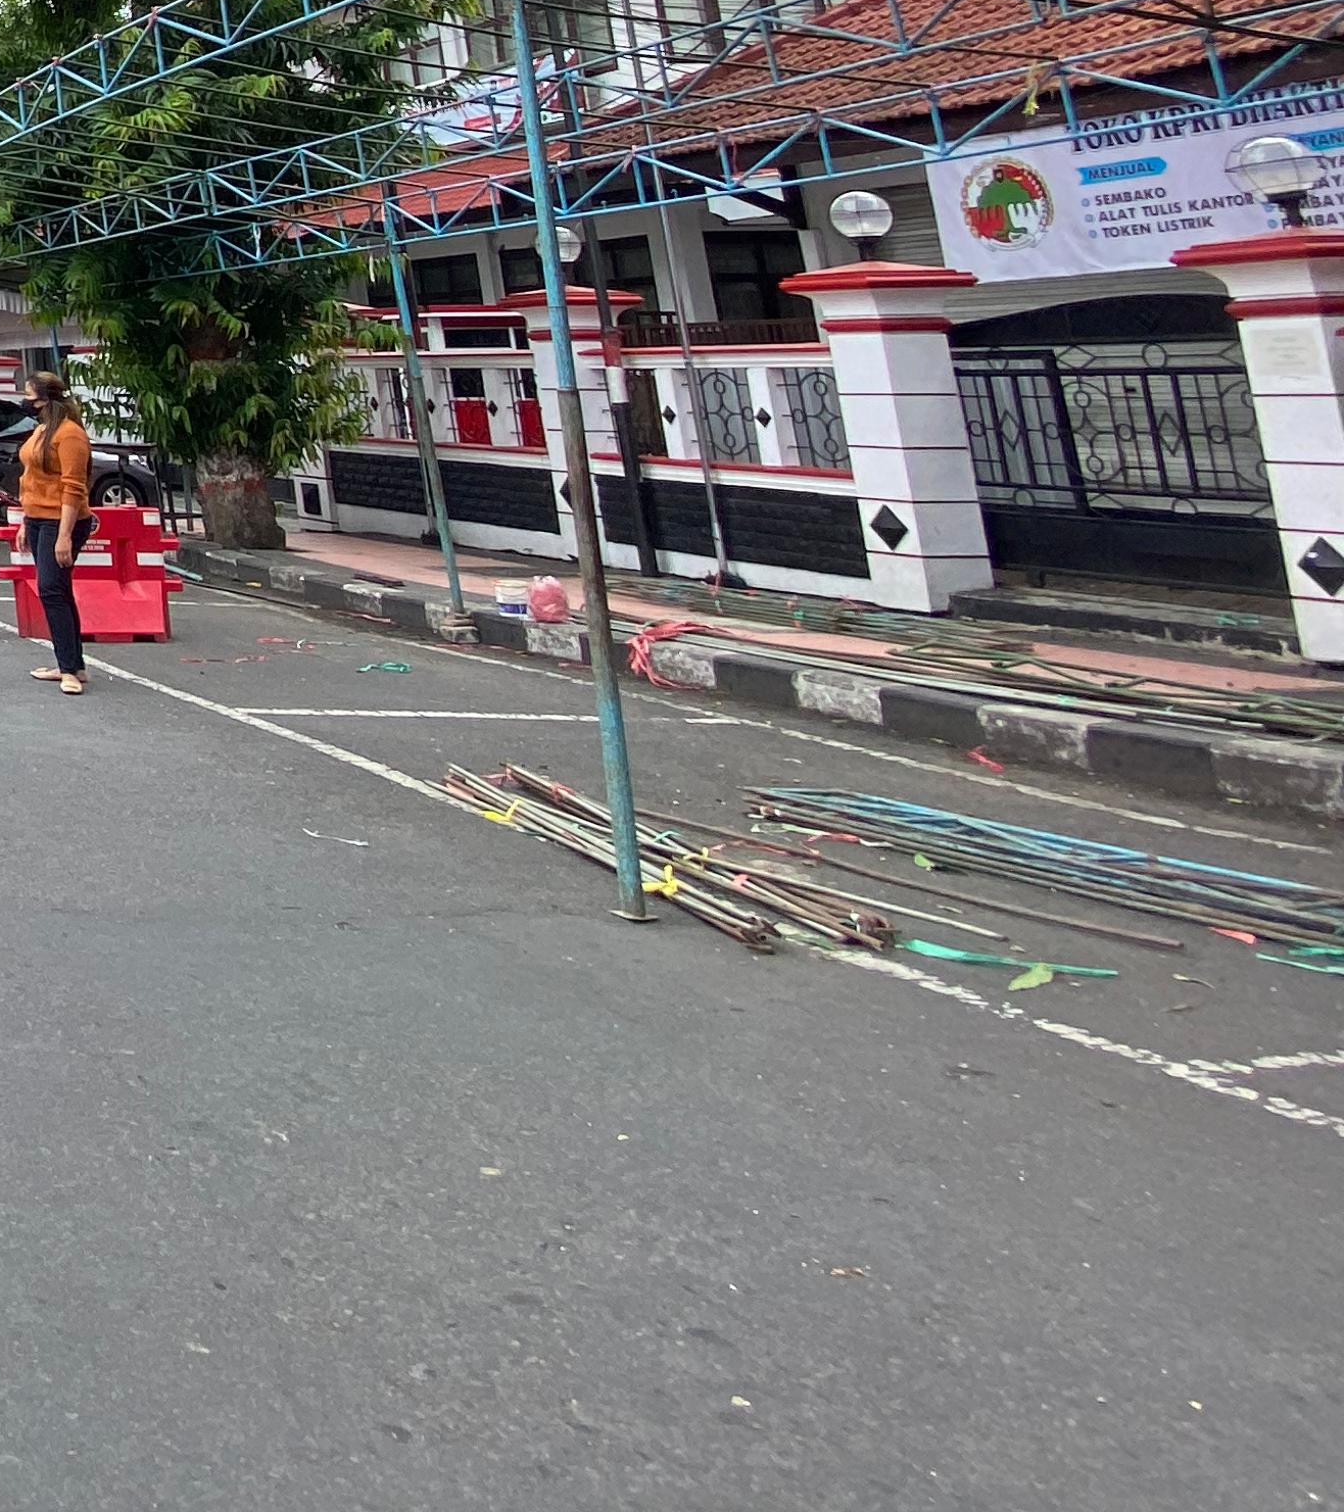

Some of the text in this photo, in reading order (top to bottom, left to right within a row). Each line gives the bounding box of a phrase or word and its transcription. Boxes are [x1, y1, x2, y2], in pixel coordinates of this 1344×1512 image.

[1087, 164, 1155, 180] MENJUAL
[1094, 187, 1167, 206] SEMBAKO
[1098, 192, 1255, 223] ALAT TULIS KANTOR
[1101, 215, 1215, 239] TOKEN LISTRIK
